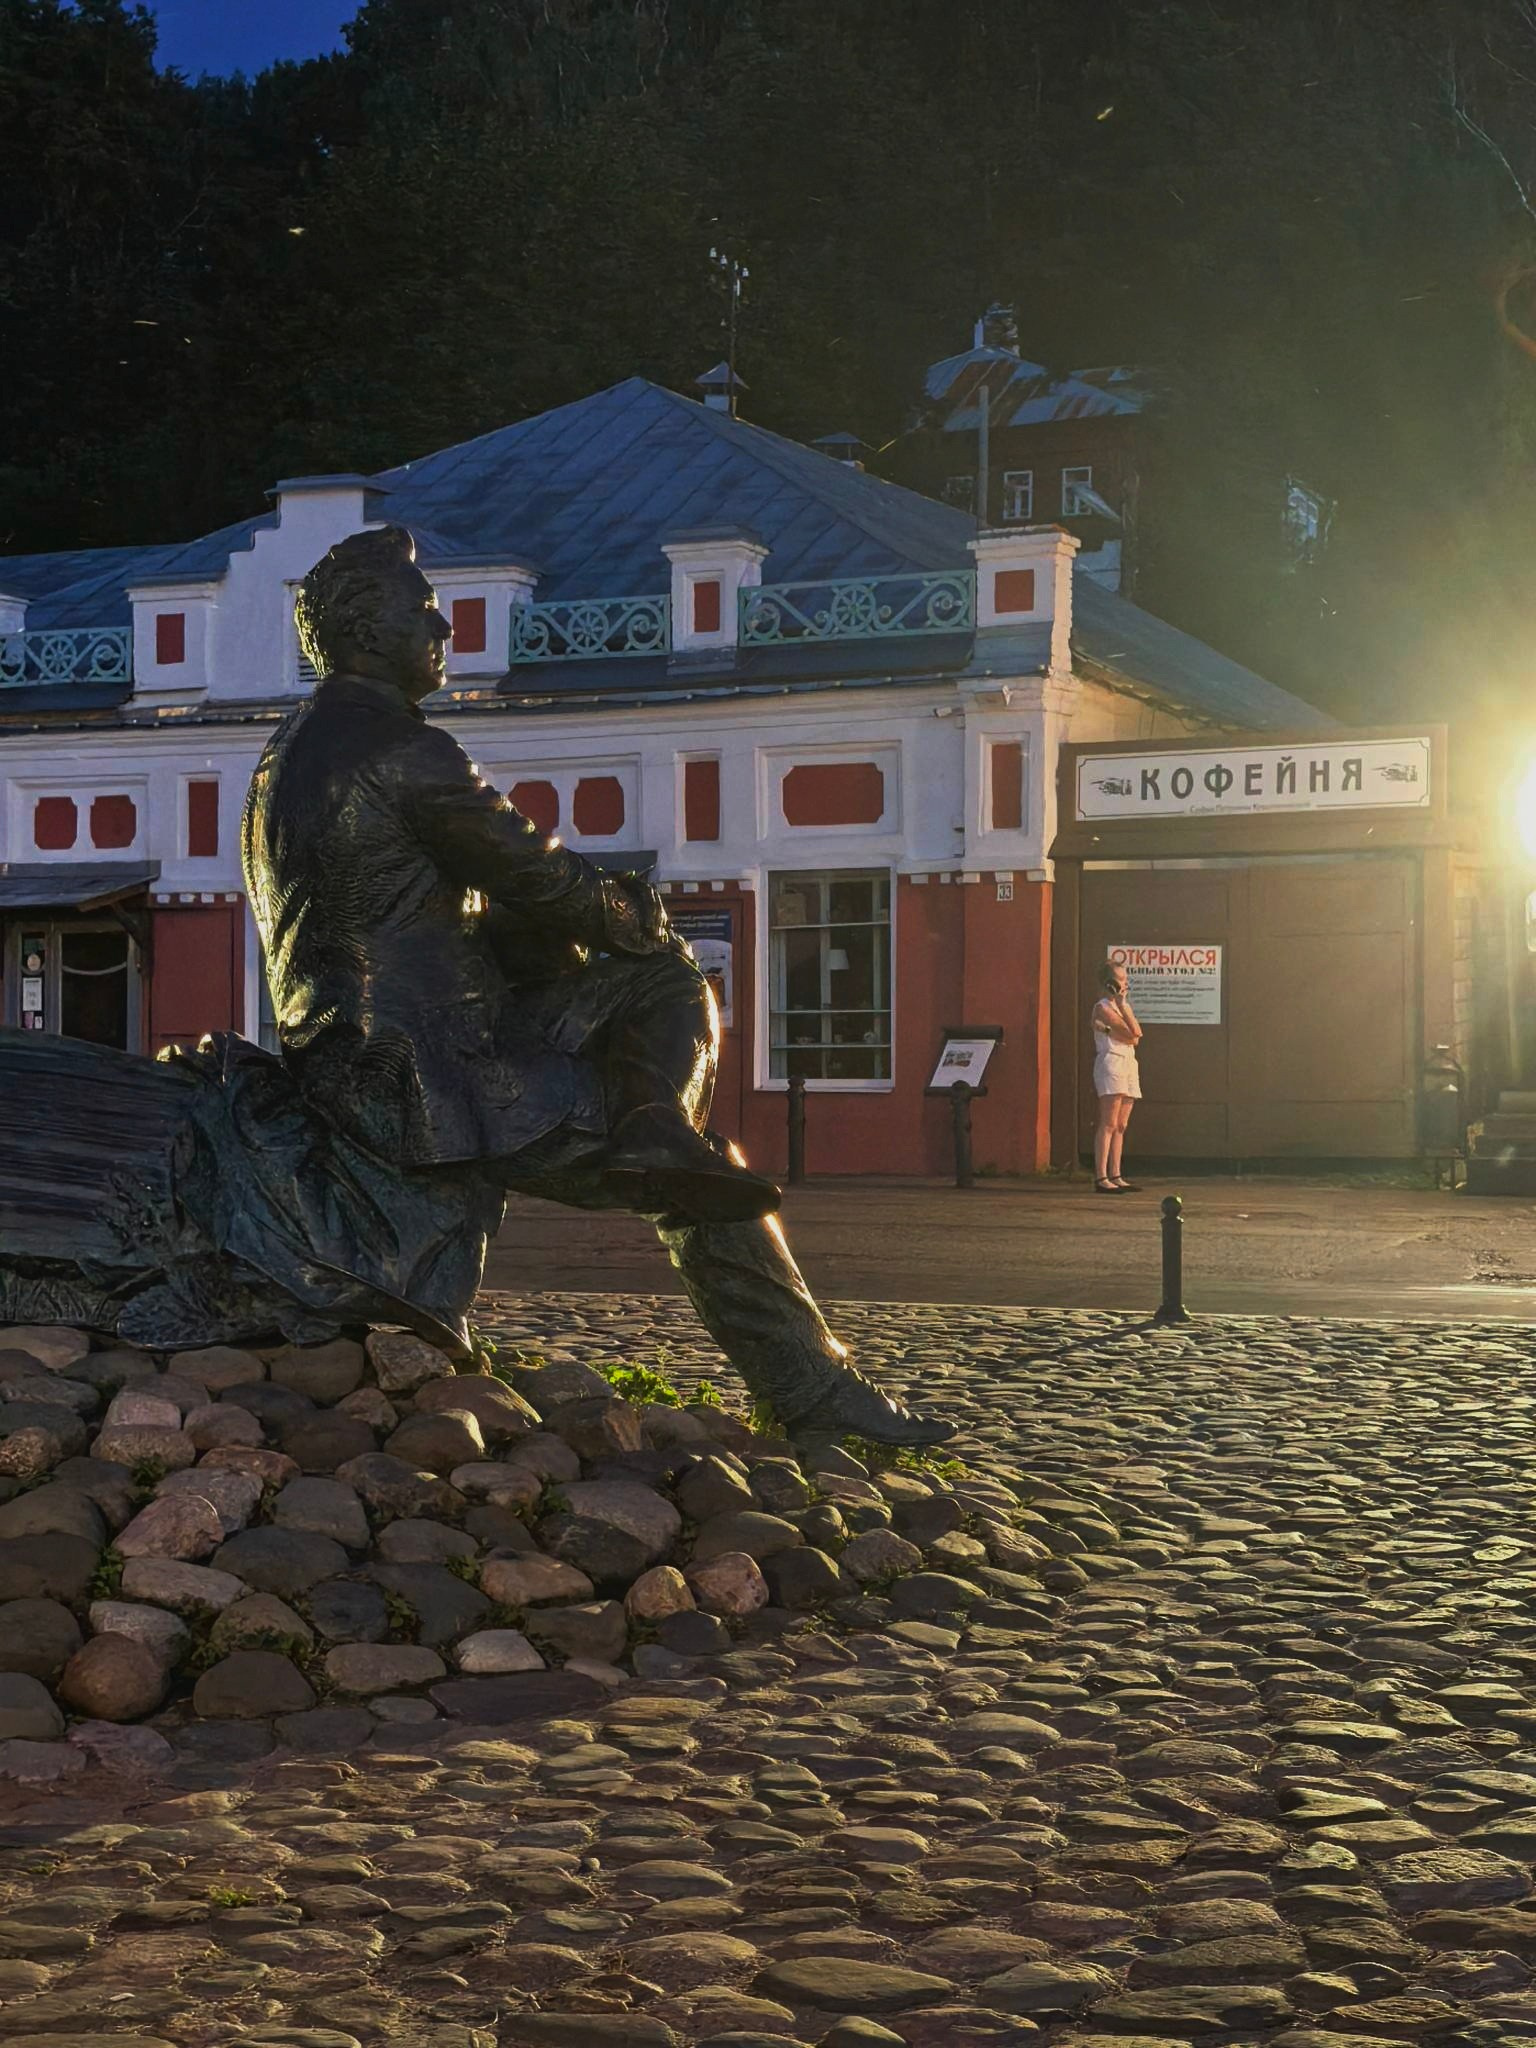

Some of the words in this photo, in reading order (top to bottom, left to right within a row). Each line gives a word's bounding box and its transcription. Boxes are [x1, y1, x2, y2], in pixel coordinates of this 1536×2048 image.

[1139, 756, 1364, 800] КОФЕЙНЯ
[1111, 949, 1217, 966] ОТКРЫЛСЯ
[1125, 966, 1164, 976] ЬНЫЙ
[1167, 966, 1195, 976] УГОЛ
